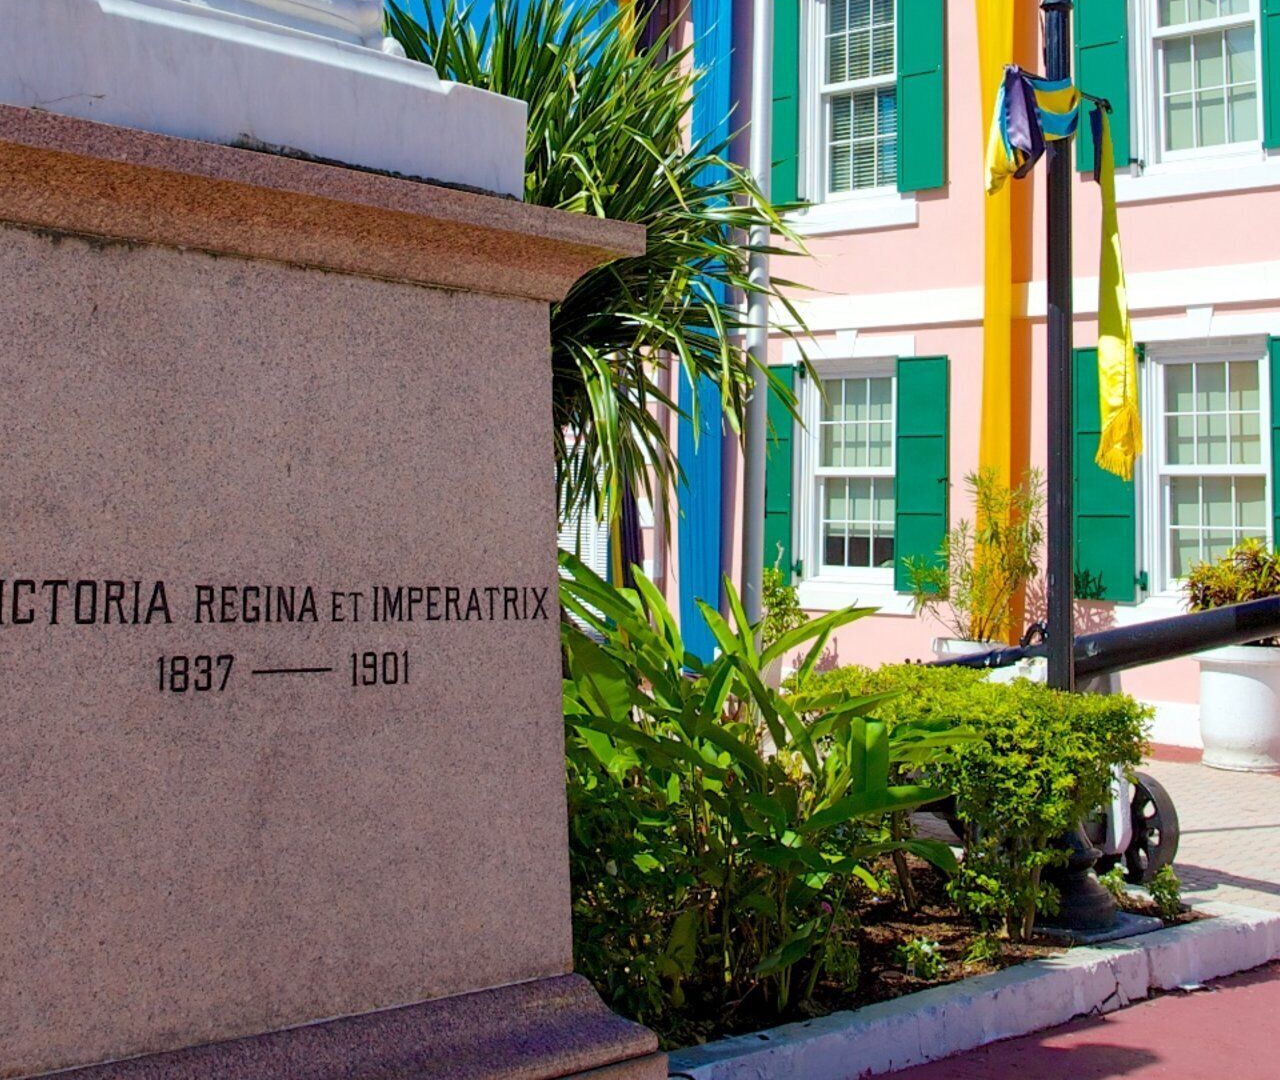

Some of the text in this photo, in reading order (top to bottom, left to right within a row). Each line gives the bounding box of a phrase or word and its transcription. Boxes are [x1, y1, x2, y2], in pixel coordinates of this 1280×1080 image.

[193, 584, 319, 623] REGINA
[330, 591, 365, 622] ET
[371, 585, 550, 622] IMPERATRIX
[157, 654, 235, 692] 1837
[349, 650, 411, 687] 1901
